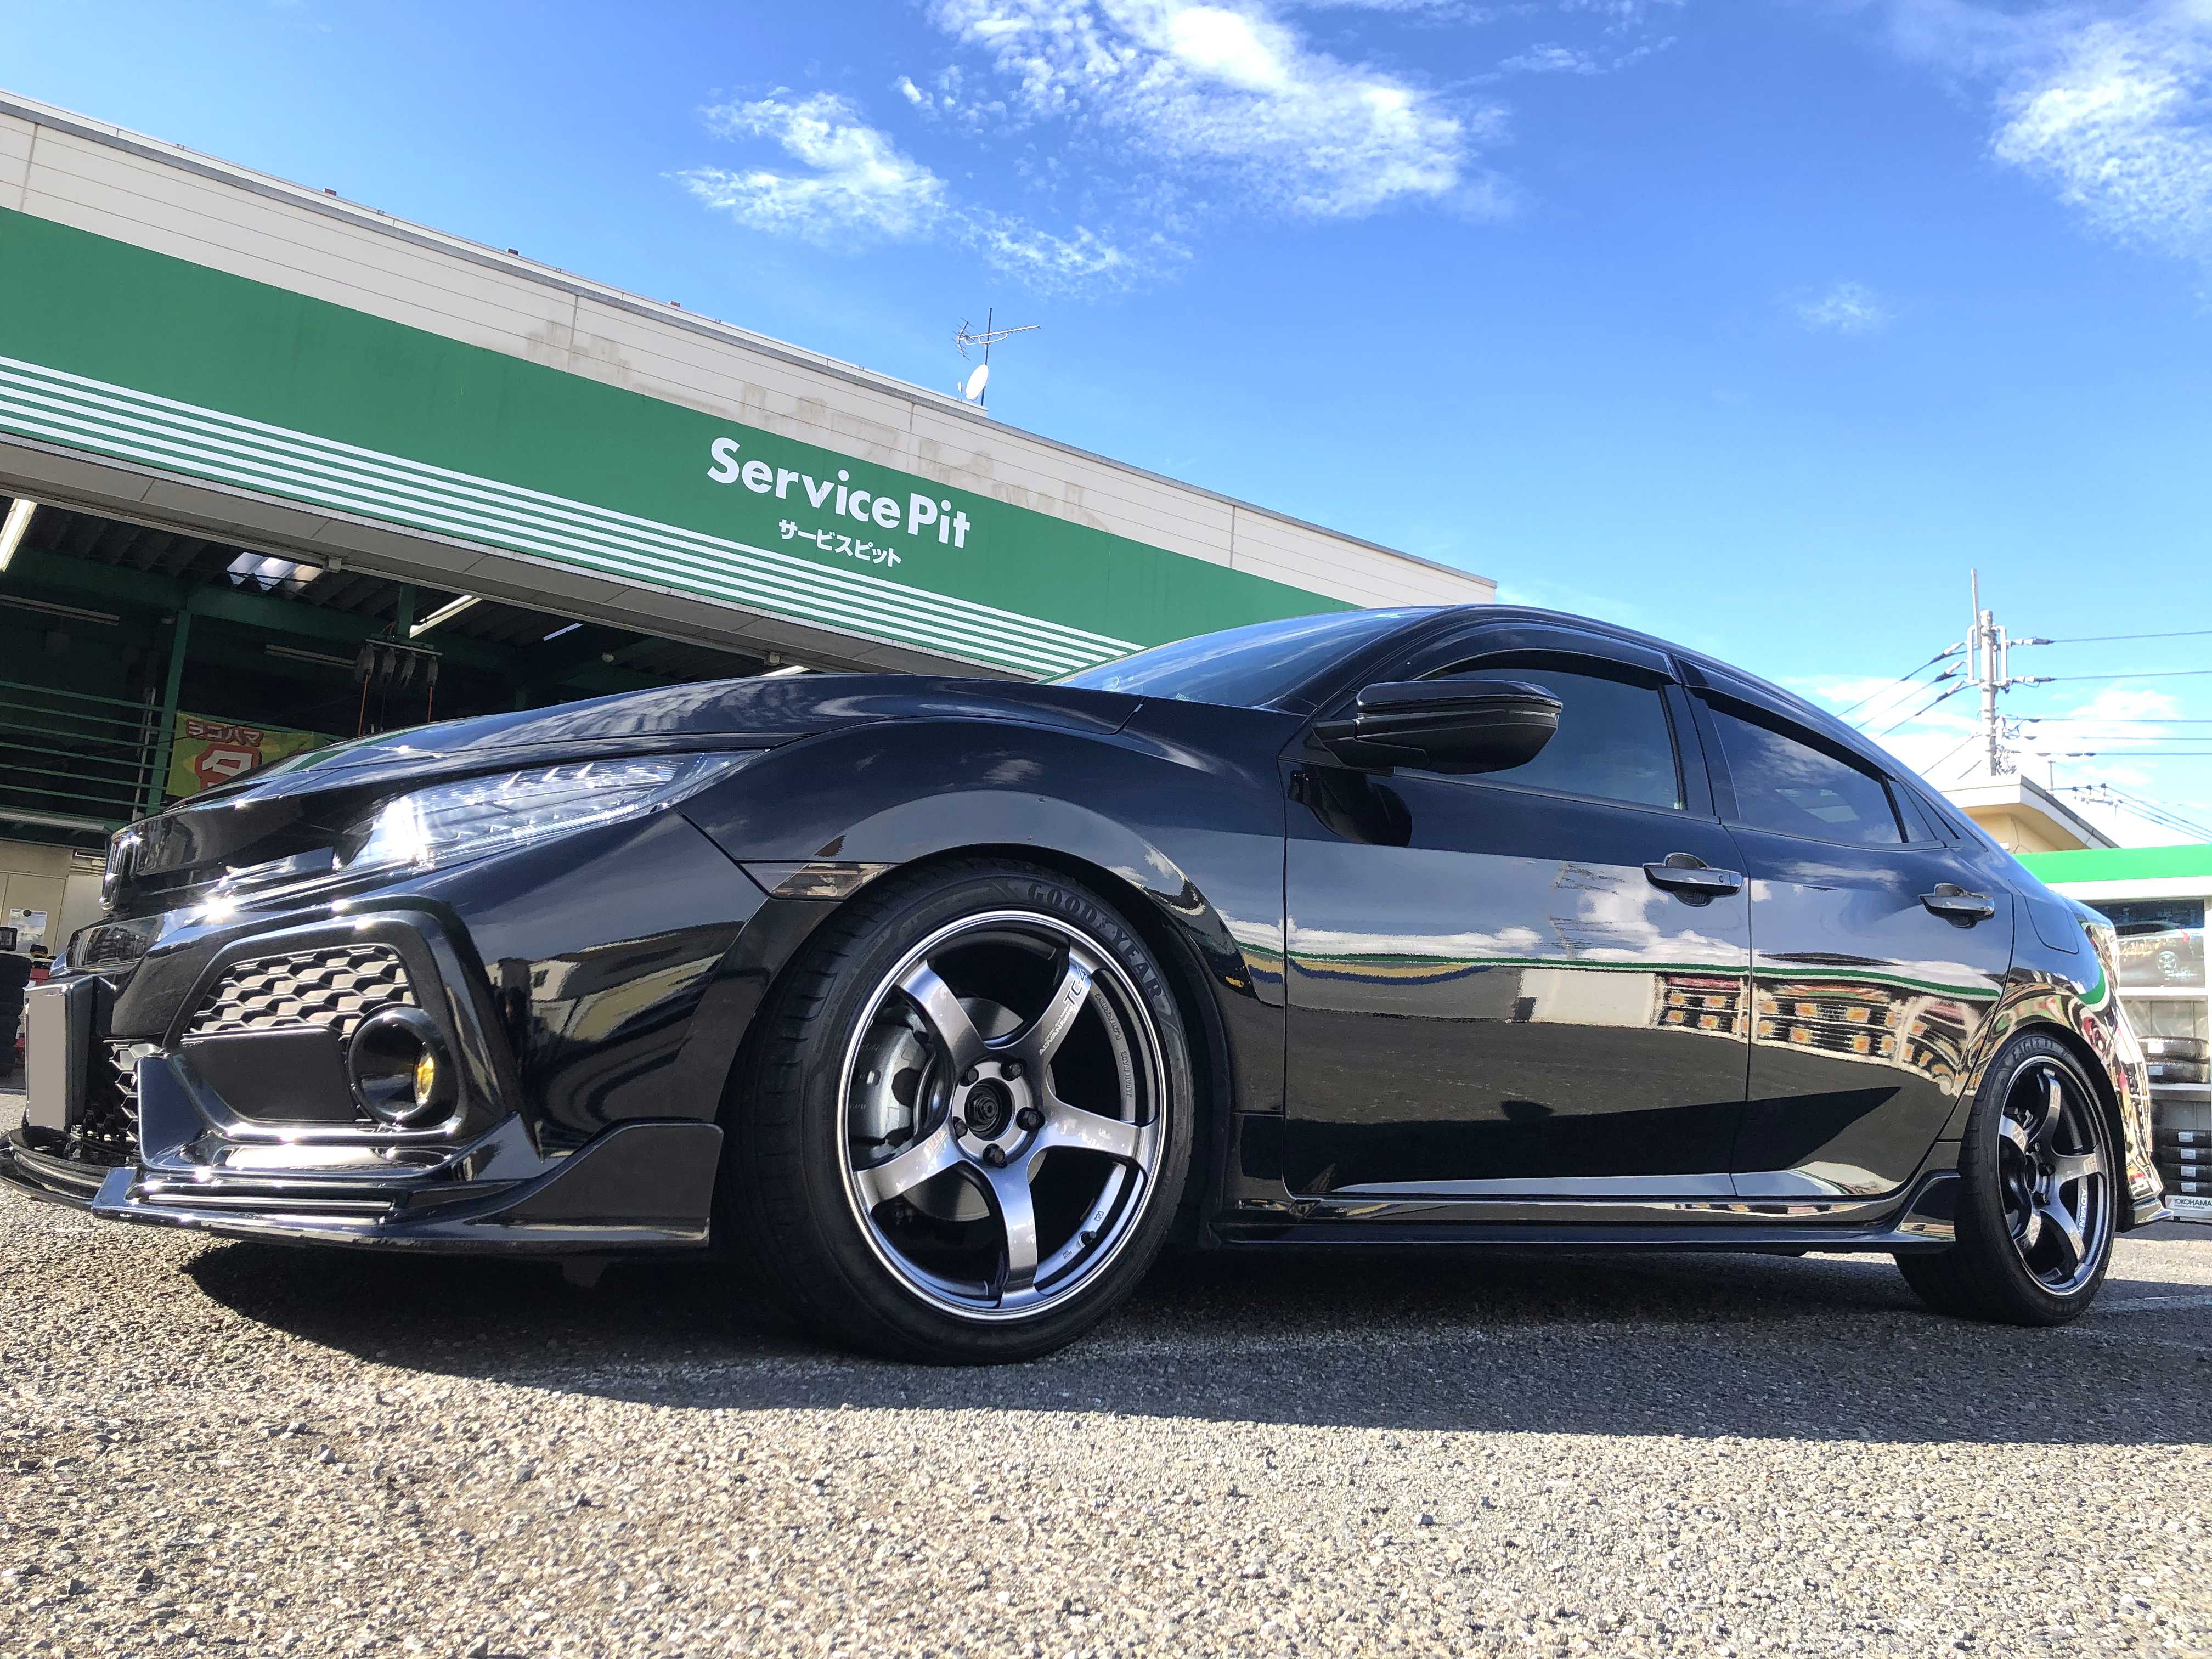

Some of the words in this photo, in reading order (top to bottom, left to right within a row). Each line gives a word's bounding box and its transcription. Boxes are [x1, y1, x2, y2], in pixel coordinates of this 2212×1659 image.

[707, 437, 900, 529] Service
[908, 492, 970, 548] Pit
[778, 518, 901, 567] サービスピット
[188, 720, 262, 745] ヨコハマ
[1028, 883, 1163, 998] GOODYEAR
[2079, 1188, 2087, 1228] ADVAN
[2174, 1198, 2212, 1207] YOKOHAMA
